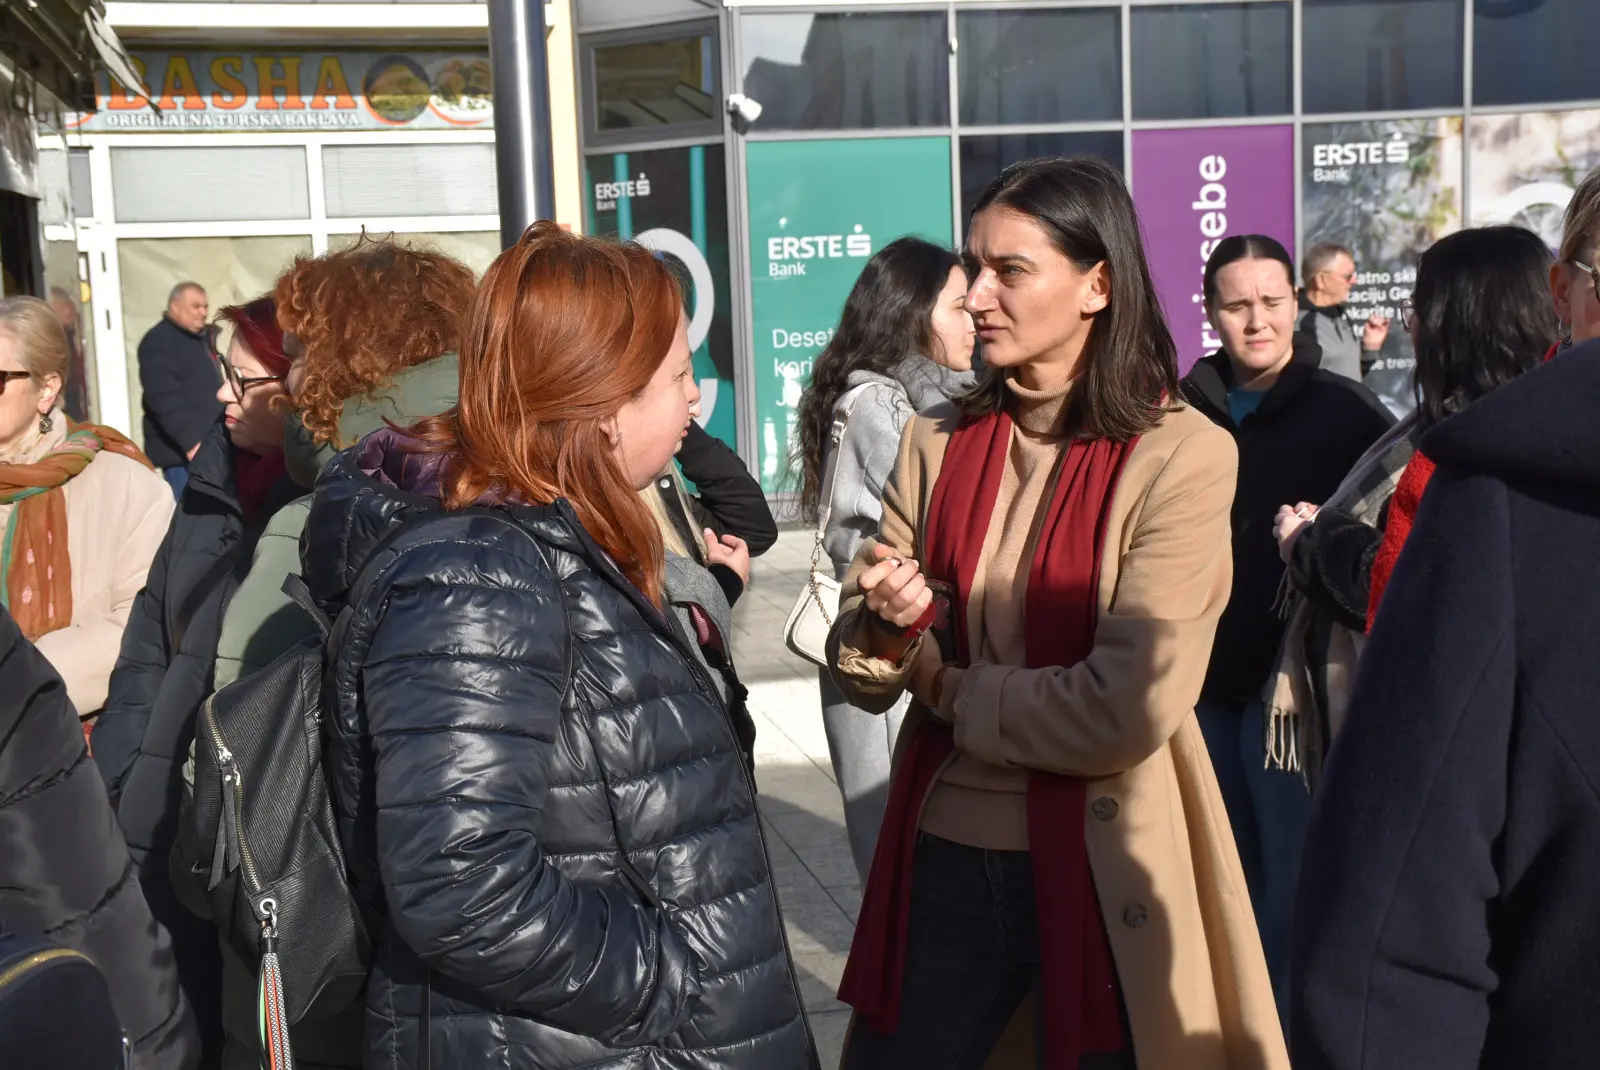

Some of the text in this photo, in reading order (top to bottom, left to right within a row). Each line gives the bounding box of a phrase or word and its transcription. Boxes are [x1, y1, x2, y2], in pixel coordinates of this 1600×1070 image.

[107, 56, 358, 110] BASHA
[215, 112, 281, 127] TURSKA
[284, 111, 360, 127] BAKLAVA
[1313, 142, 1383, 167] ERSTE
[1313, 167, 1350, 182] Bank
[595, 181, 636, 200] ERSTE
[768, 235, 843, 260] ERSTE
[768, 261, 806, 277] Bank
